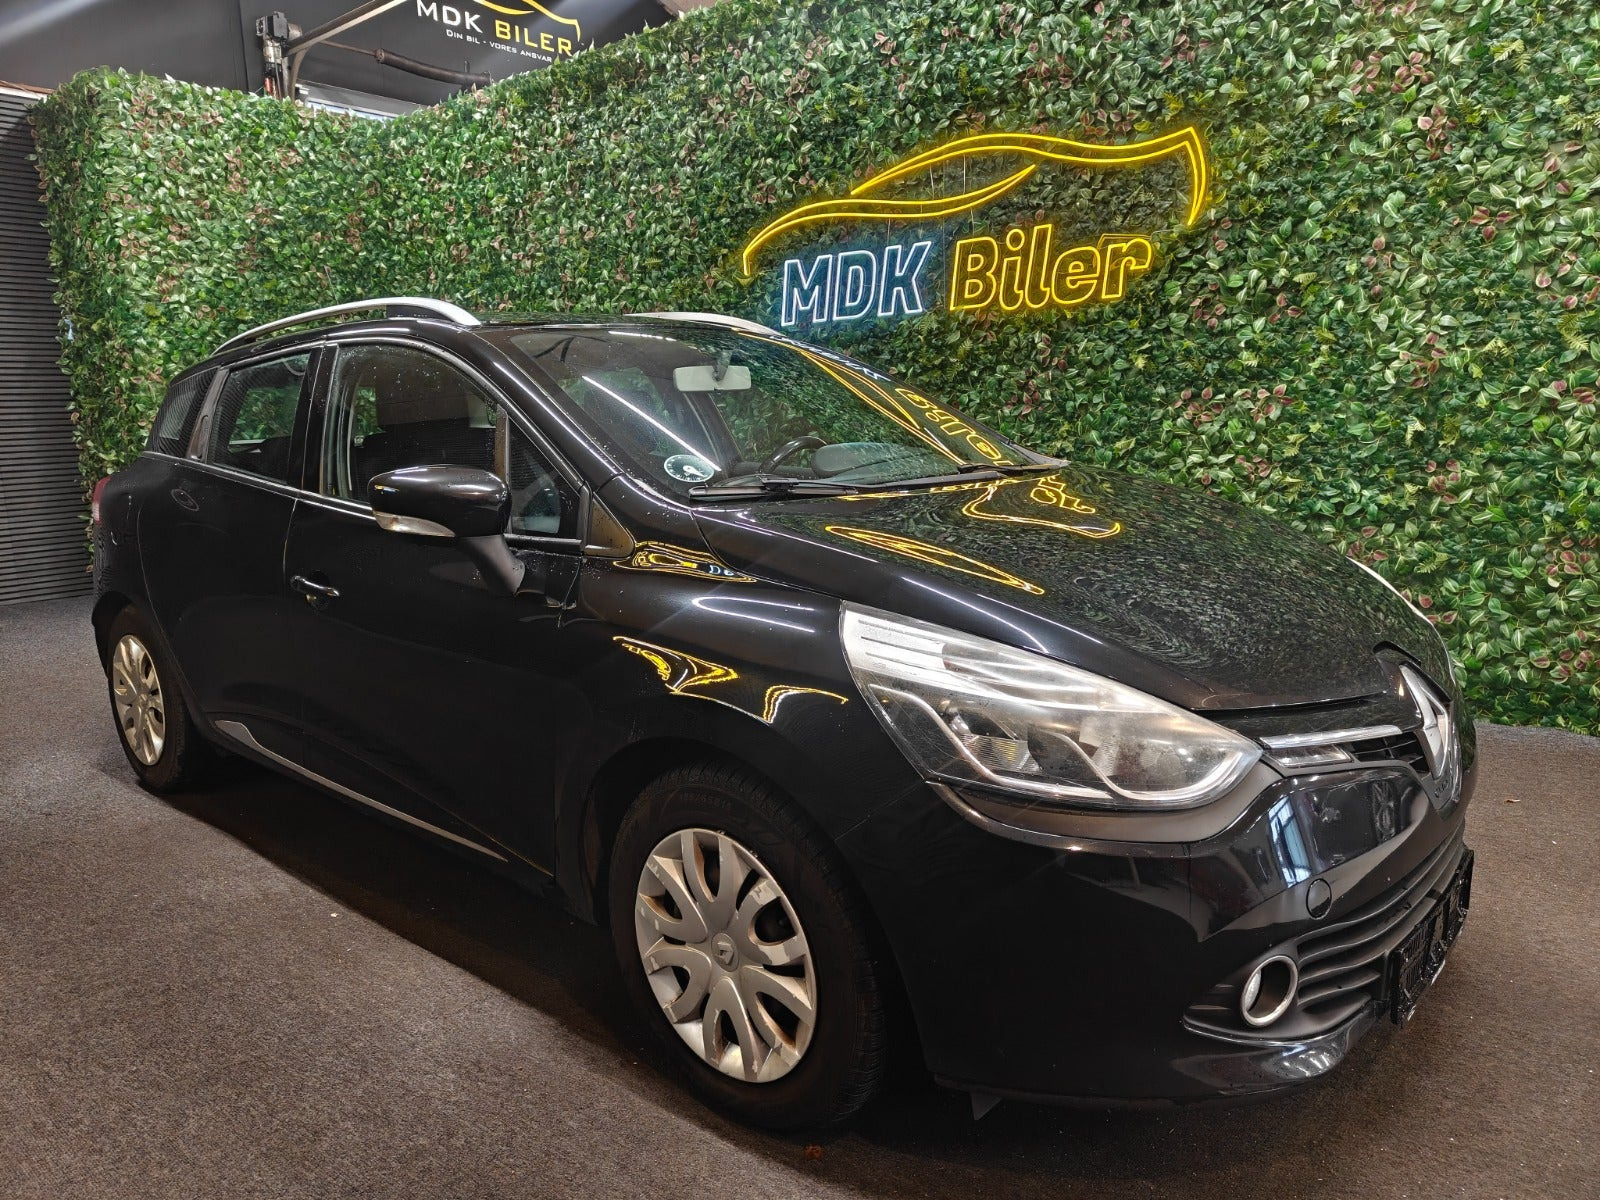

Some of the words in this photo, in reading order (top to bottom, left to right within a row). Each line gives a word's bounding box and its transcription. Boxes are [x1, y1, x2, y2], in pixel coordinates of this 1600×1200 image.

[416, 0, 483, 34] MDK
[495, 19, 572, 57] BILER
[466, 34, 480, 45] BIL
[489, 41, 517, 54] VORES
[520, 50, 552, 63] ANSVAR
[781, 240, 933, 327] MDK
[949, 223, 1153, 311] Biler
